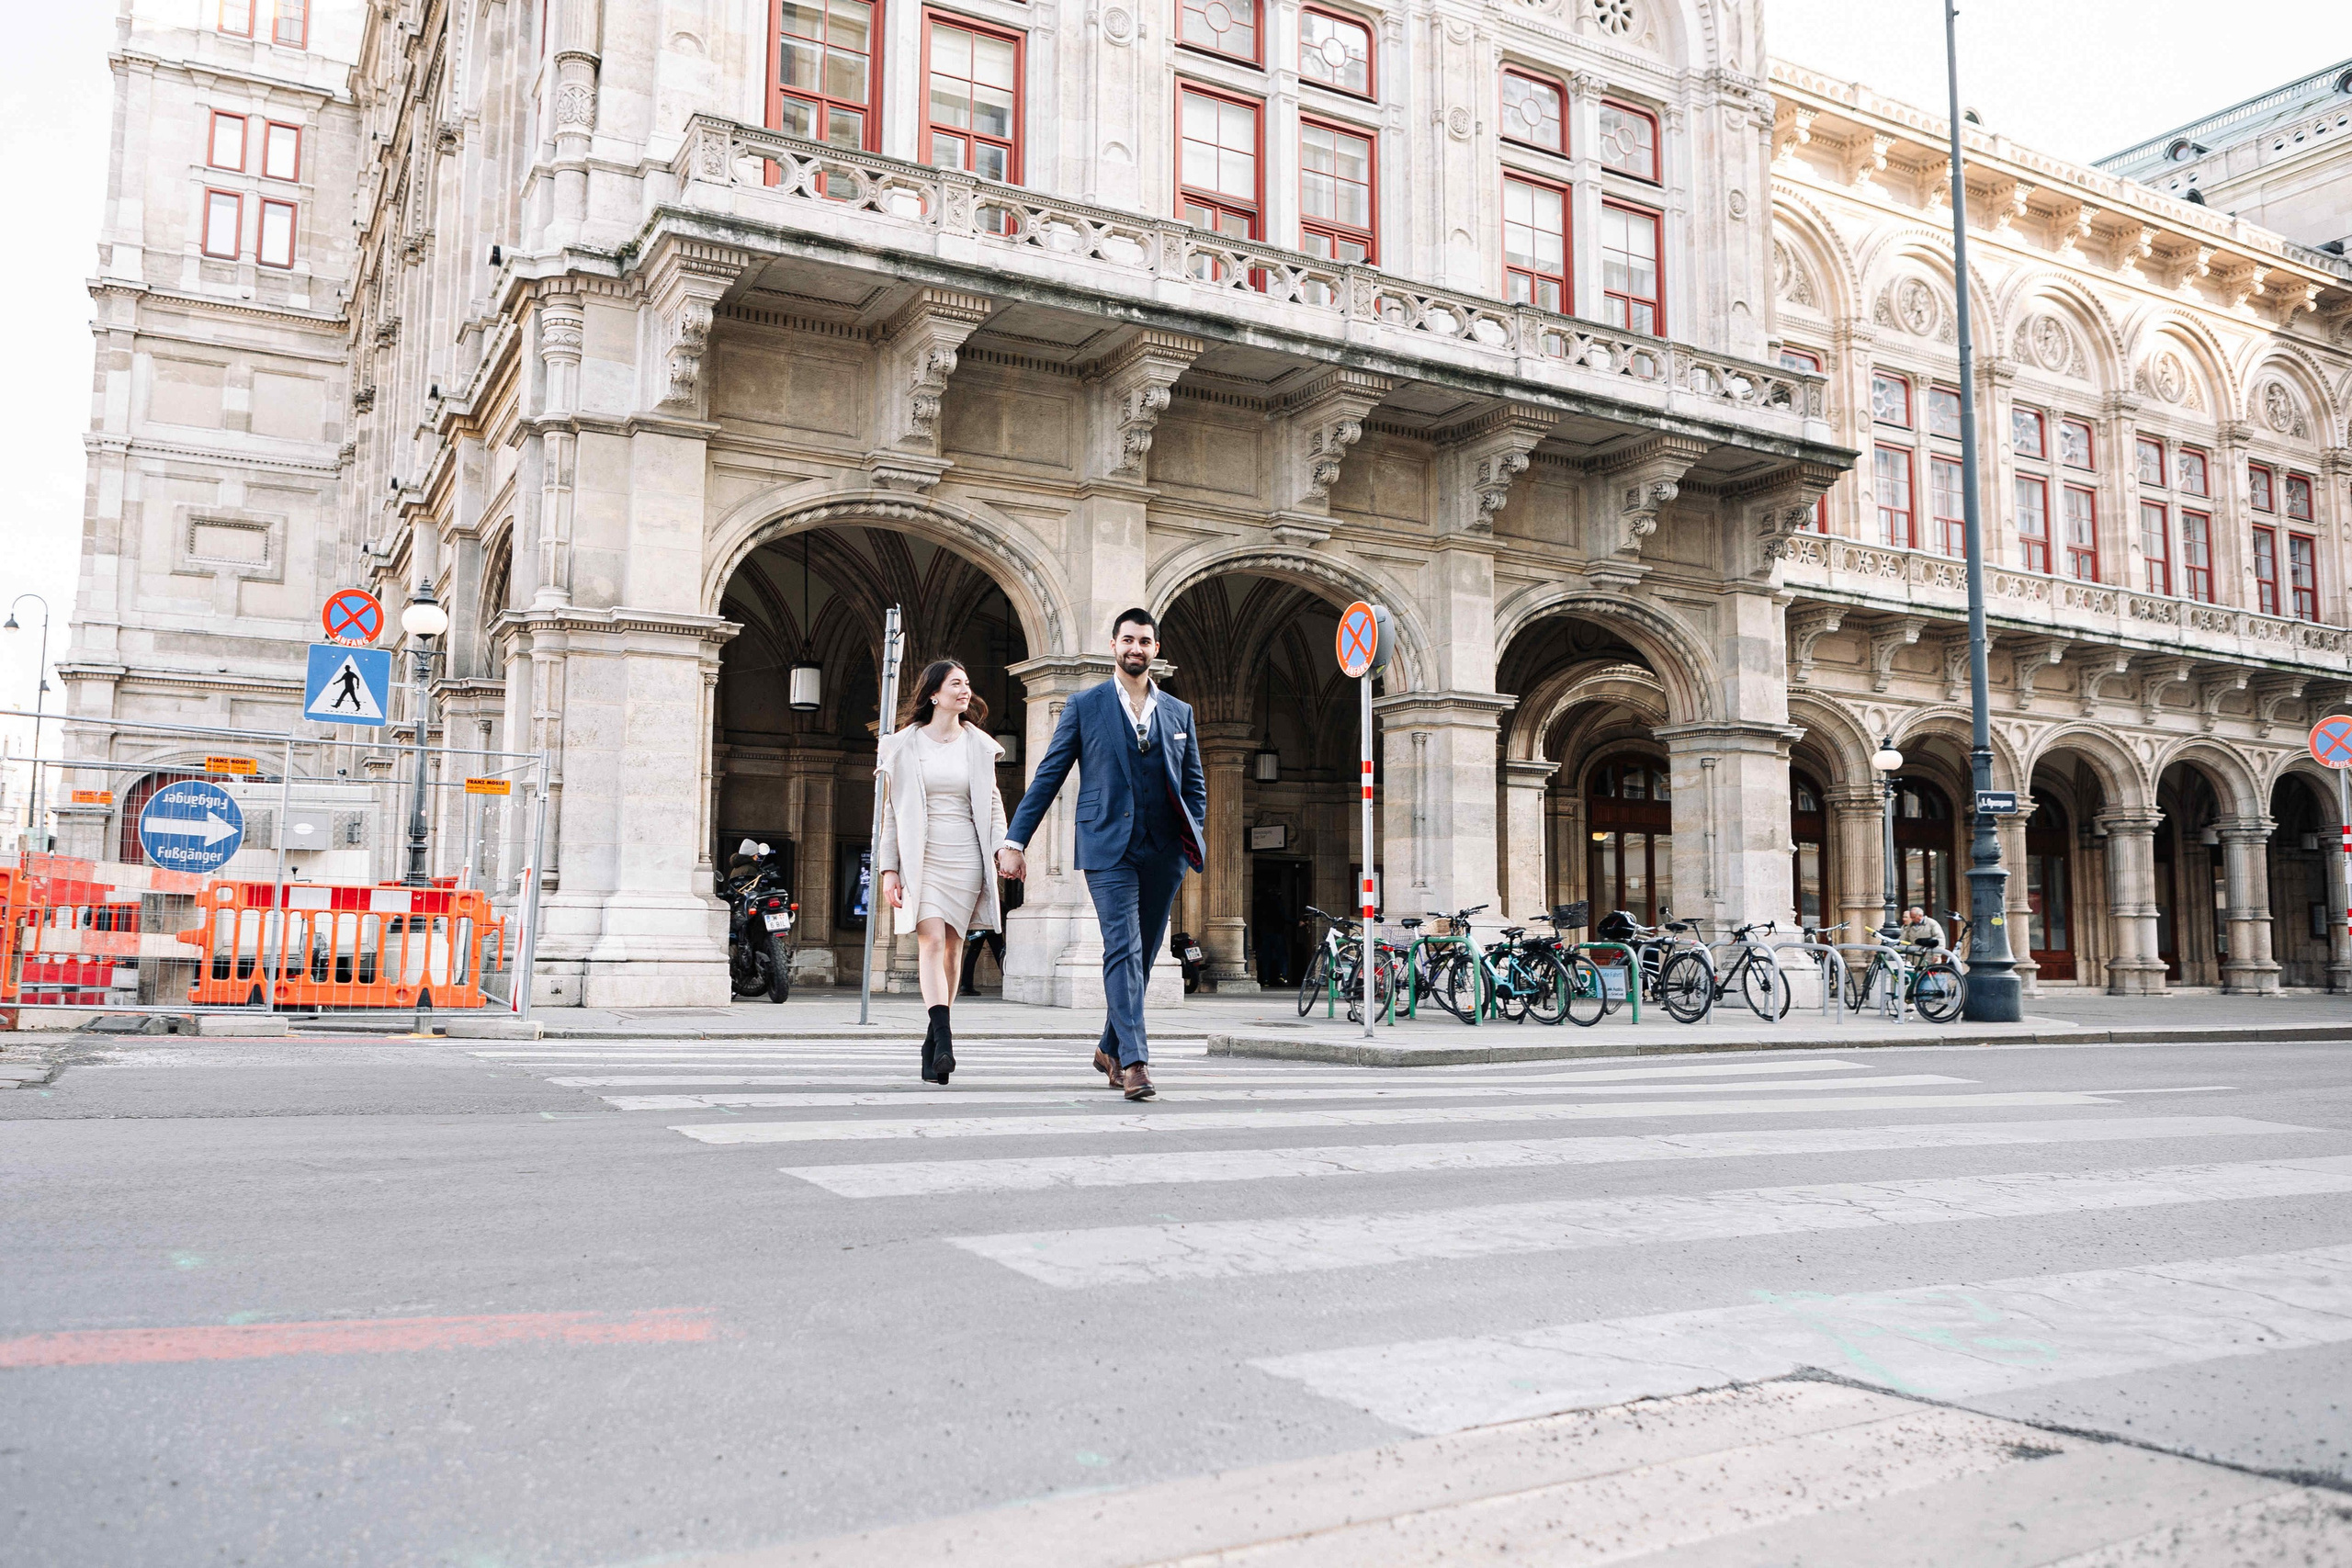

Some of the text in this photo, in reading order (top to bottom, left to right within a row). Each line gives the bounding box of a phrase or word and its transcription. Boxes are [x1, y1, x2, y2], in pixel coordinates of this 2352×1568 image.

[334, 634, 369, 647] ANFANG
[1346, 661, 1369, 676] ANFANG
[2328, 759, 2350, 768] ENDE
[162, 792, 228, 809] Fußgänger
[157, 846, 223, 863] Fußgänger
